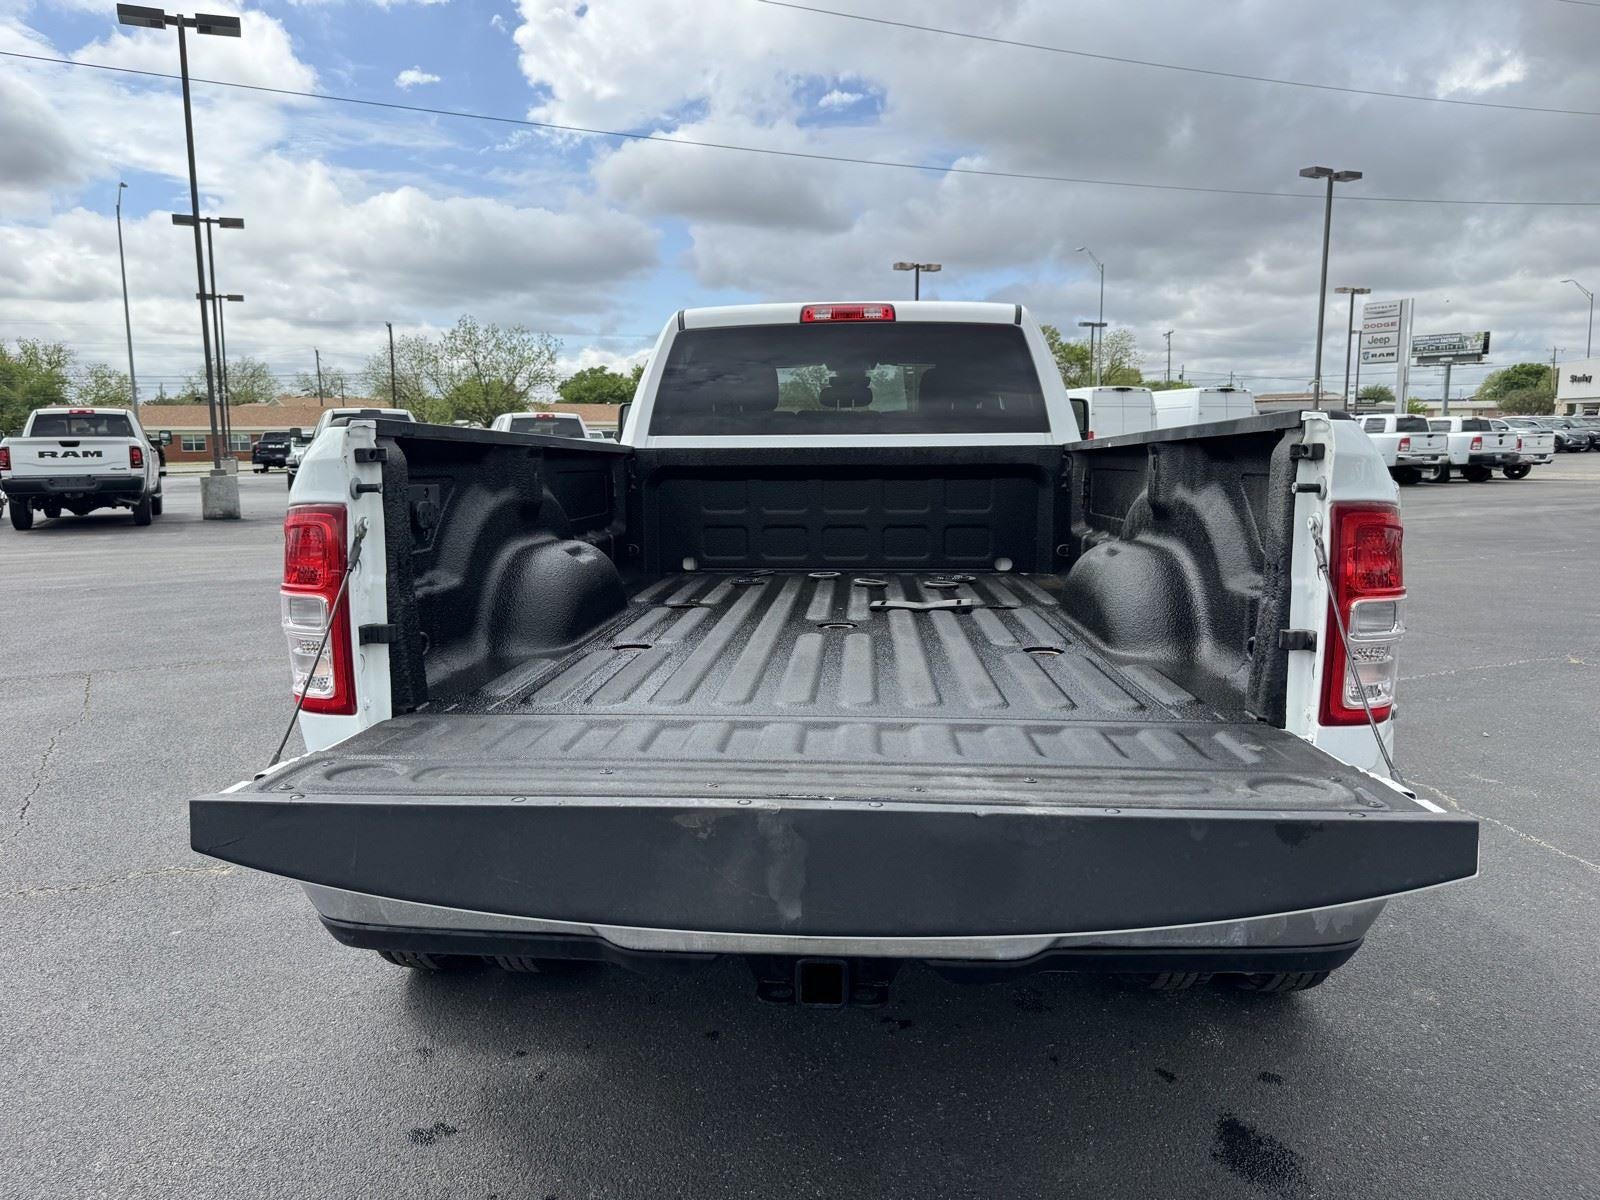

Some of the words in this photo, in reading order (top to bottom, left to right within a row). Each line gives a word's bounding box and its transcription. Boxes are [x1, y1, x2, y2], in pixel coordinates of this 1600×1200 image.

[1364, 321, 1397, 329] DODGE
[1368, 335, 1390, 345] Jeep
[38, 450, 103, 458] RAM
